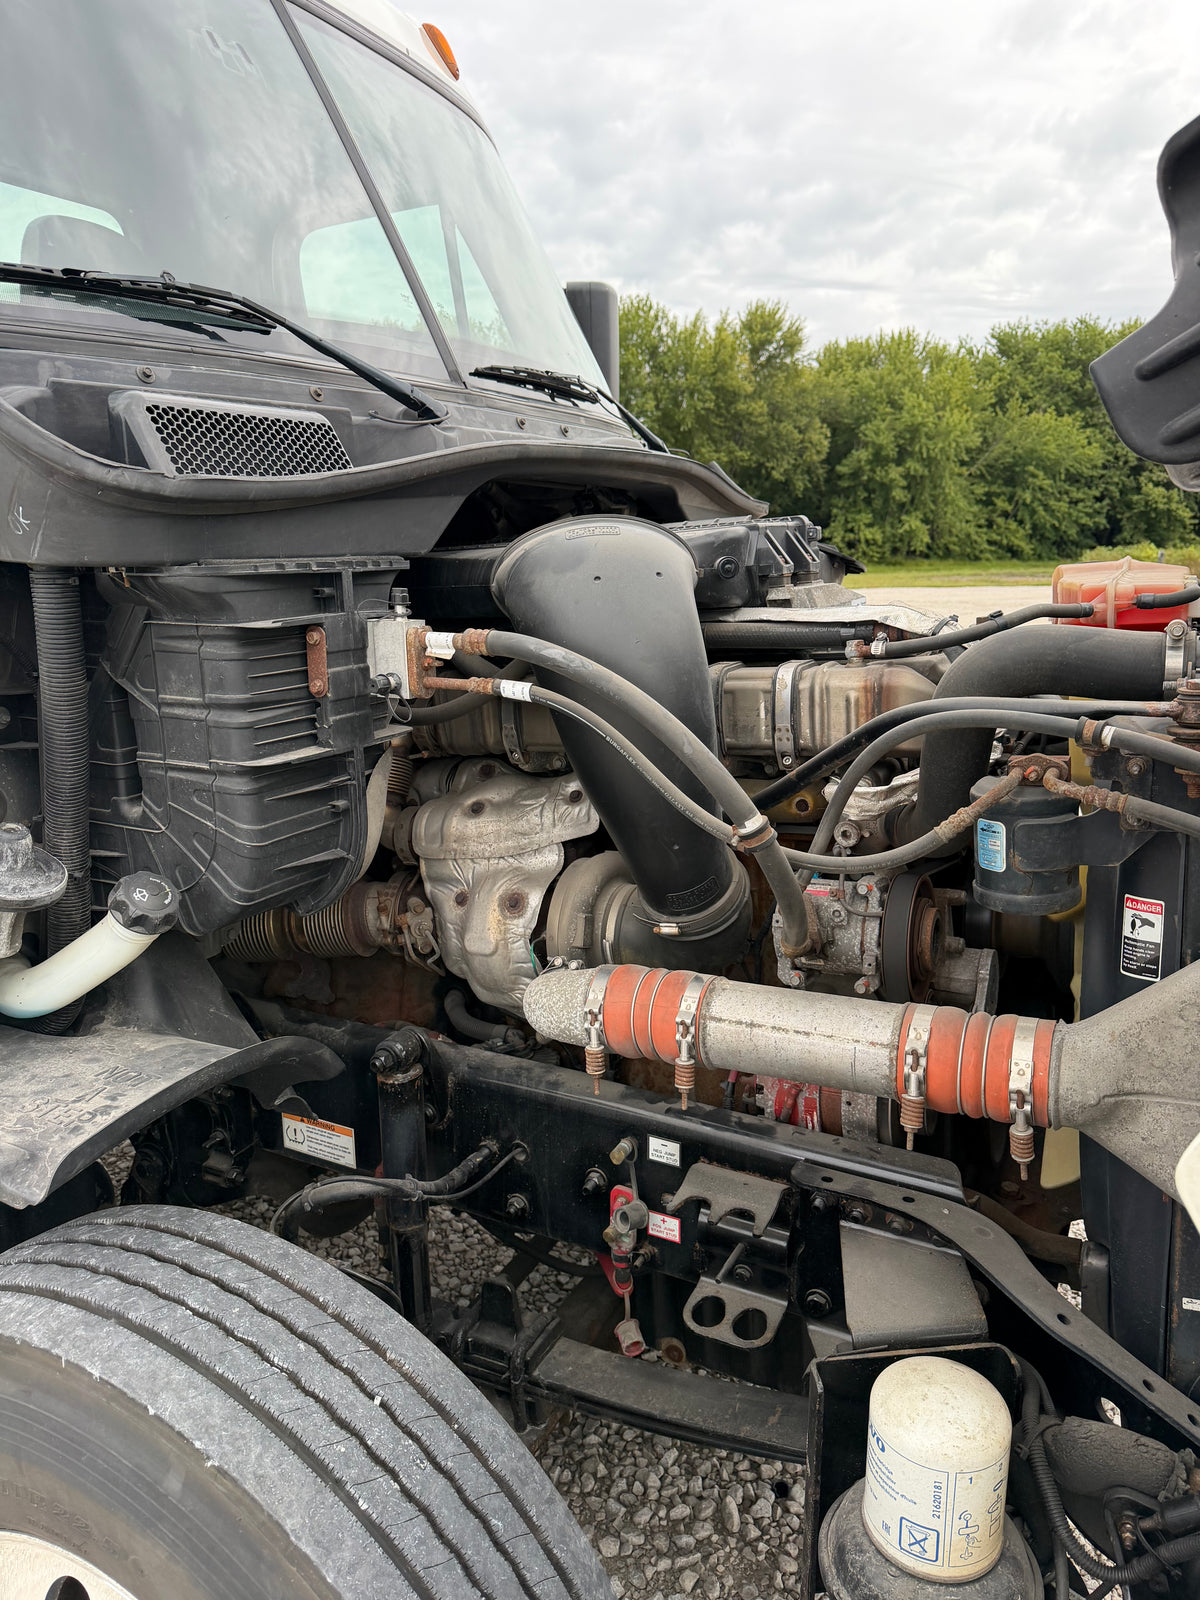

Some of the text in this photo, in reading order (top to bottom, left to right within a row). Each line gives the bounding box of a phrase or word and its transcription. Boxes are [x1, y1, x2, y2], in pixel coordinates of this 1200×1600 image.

[605, 735, 637, 766] BURGAFLEX
[1132, 901, 1162, 913] DANGER
[1124, 939, 1145, 948] Automatic
[94, 1065, 162, 1088] NOT
[18, 1096, 98, 1127] STEP
[306, 1118, 336, 1132] WARNING
[651, 1152, 665, 1160] START
[651, 1227, 665, 1235] START
[932, 1480, 943, 1520] 21620181
